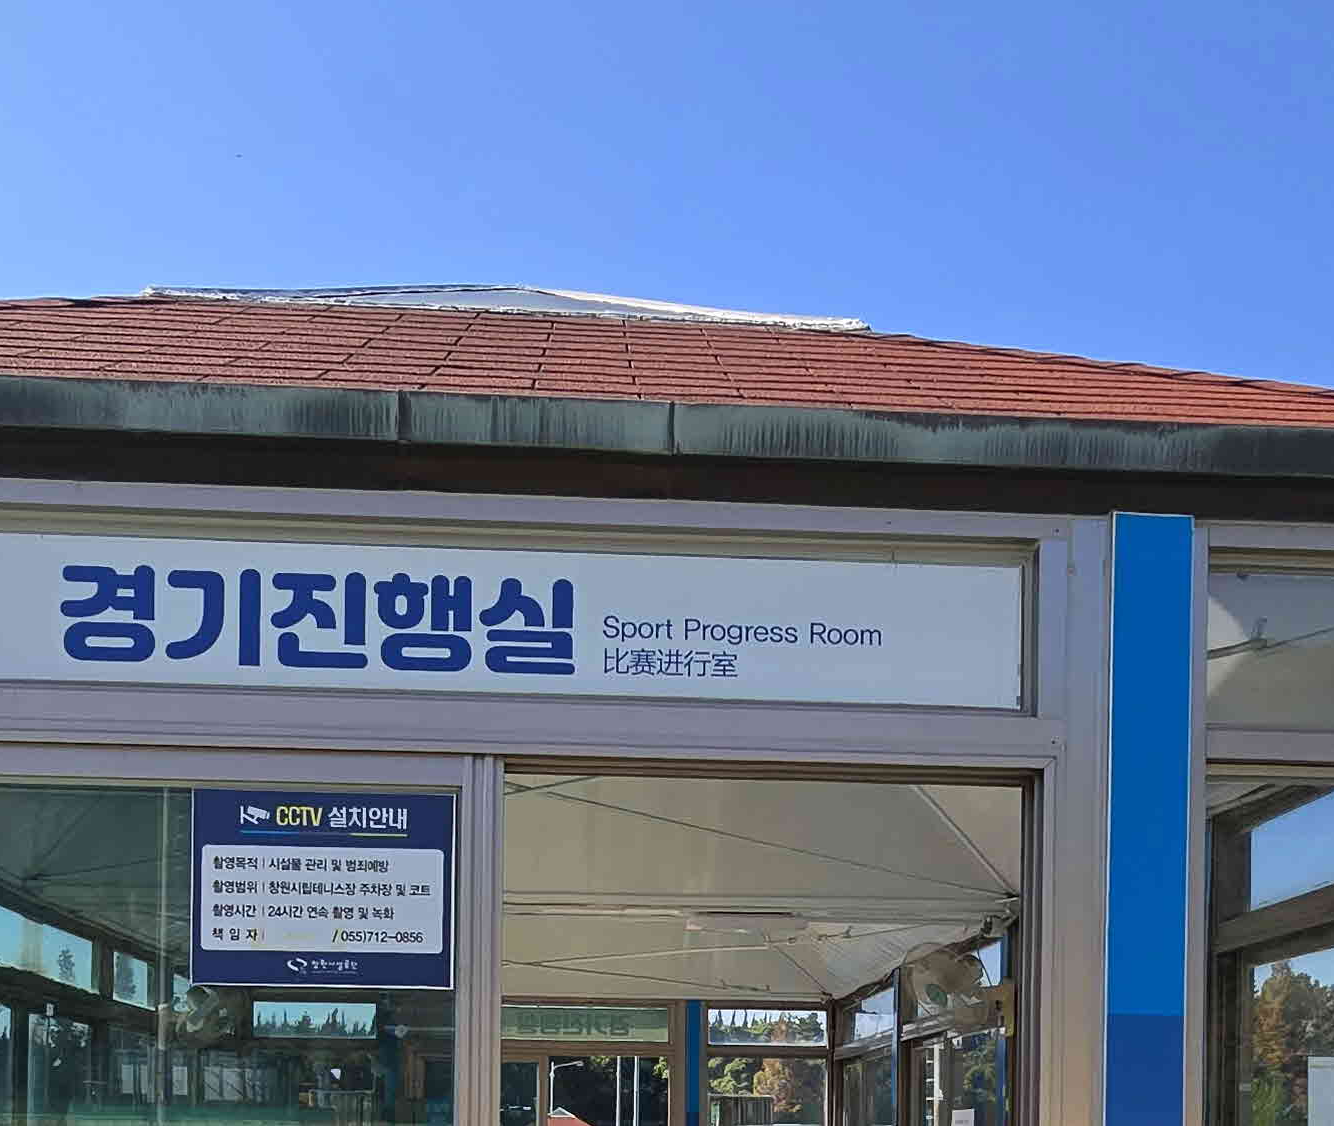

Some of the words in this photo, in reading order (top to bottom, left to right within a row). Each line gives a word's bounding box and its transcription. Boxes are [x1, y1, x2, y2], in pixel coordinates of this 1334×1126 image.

[60, 564, 574, 676] 경기진행실
[603, 615, 673, 642] Sport
[684, 619, 798, 646] Progress
[810, 623, 882, 647] Room
[603, 648, 738, 678] 比赛进行室
[276, 806, 323, 827] CCTV
[328, 807, 408, 830] 설치안내
[213, 856, 259, 870] 촬영목적
[269, 858, 302, 872] 시설물
[305, 858, 328, 872] 관리
[331, 859, 342, 872] 및
[346, 859, 390, 873] 범죄예방
[213, 880, 258, 894] 촬영범위
[268, 881, 356, 896] 창원시립테니스장
[359, 882, 393, 897] 주차장
[396, 883, 406, 897] 및
[409, 884, 432, 896] 코트
[212, 904, 257, 918] 촬영시간
[268, 905, 303, 918] 24시간
[307, 906, 329, 919] 연속
[332, 906, 354, 920] 촬영
[358, 907, 369, 920] 및
[372, 907, 394, 920] 녹화
